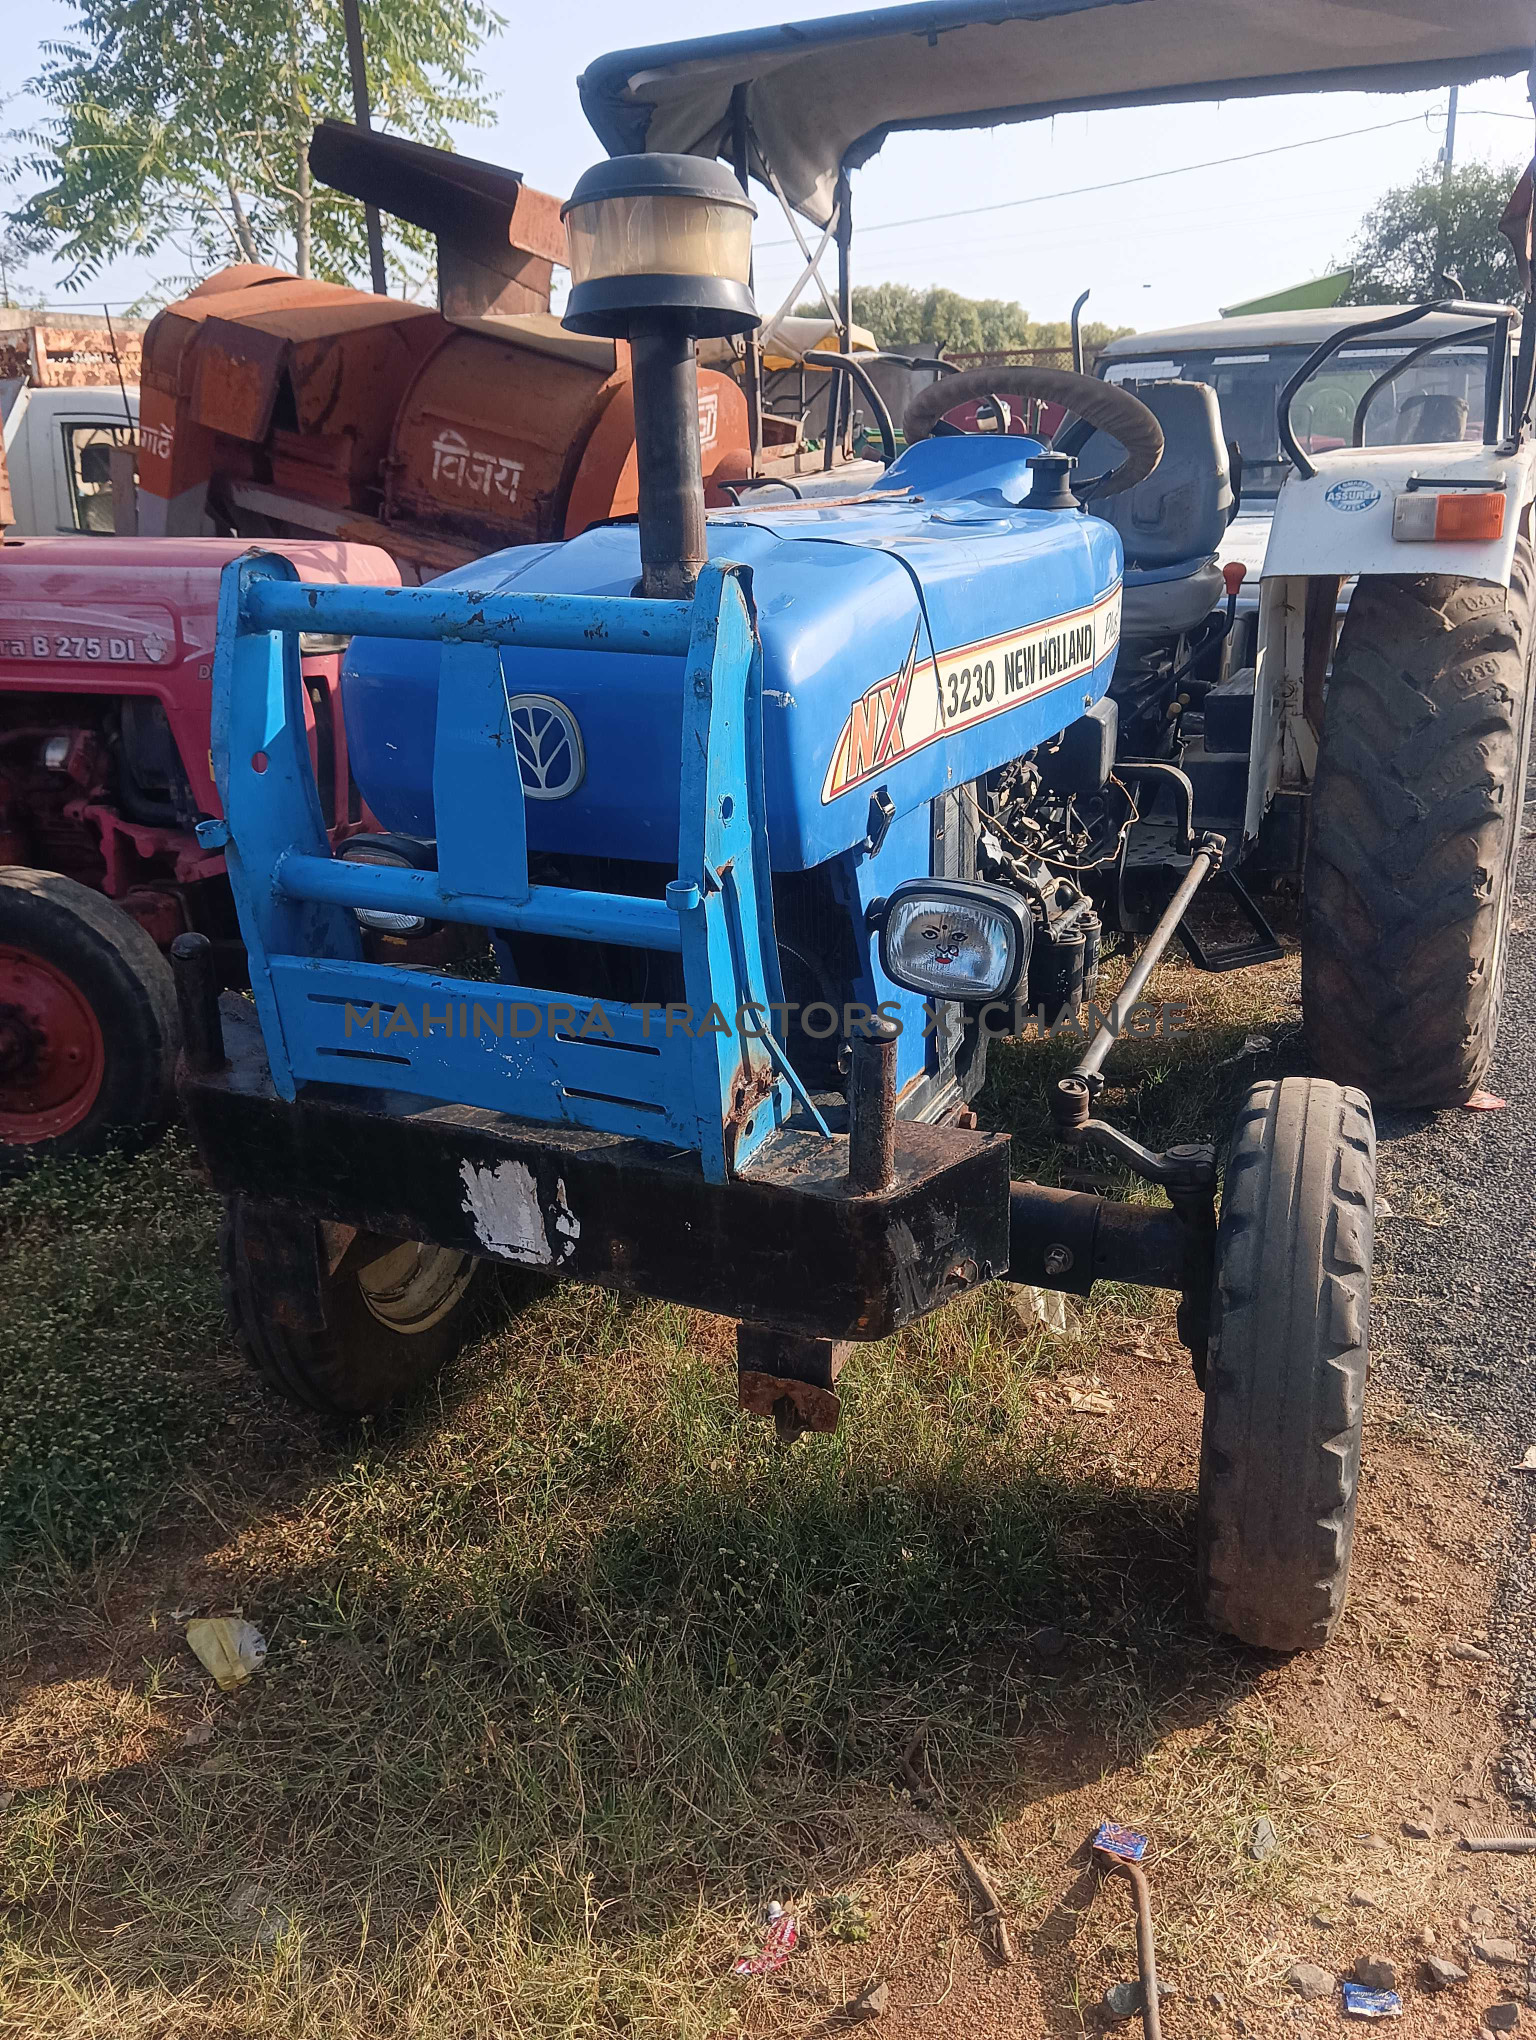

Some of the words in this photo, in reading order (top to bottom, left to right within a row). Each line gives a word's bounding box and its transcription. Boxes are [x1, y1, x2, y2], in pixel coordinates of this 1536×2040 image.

[432, 429, 525, 503] विजय
[33, 636, 49, 657] B
[56, 637, 101, 659] 275
[109, 639, 135, 660] DI
[947, 660, 995, 718] 3230
[1004, 643, 1036, 695] NEW
[1039, 624, 1092, 680] HOLLAND
